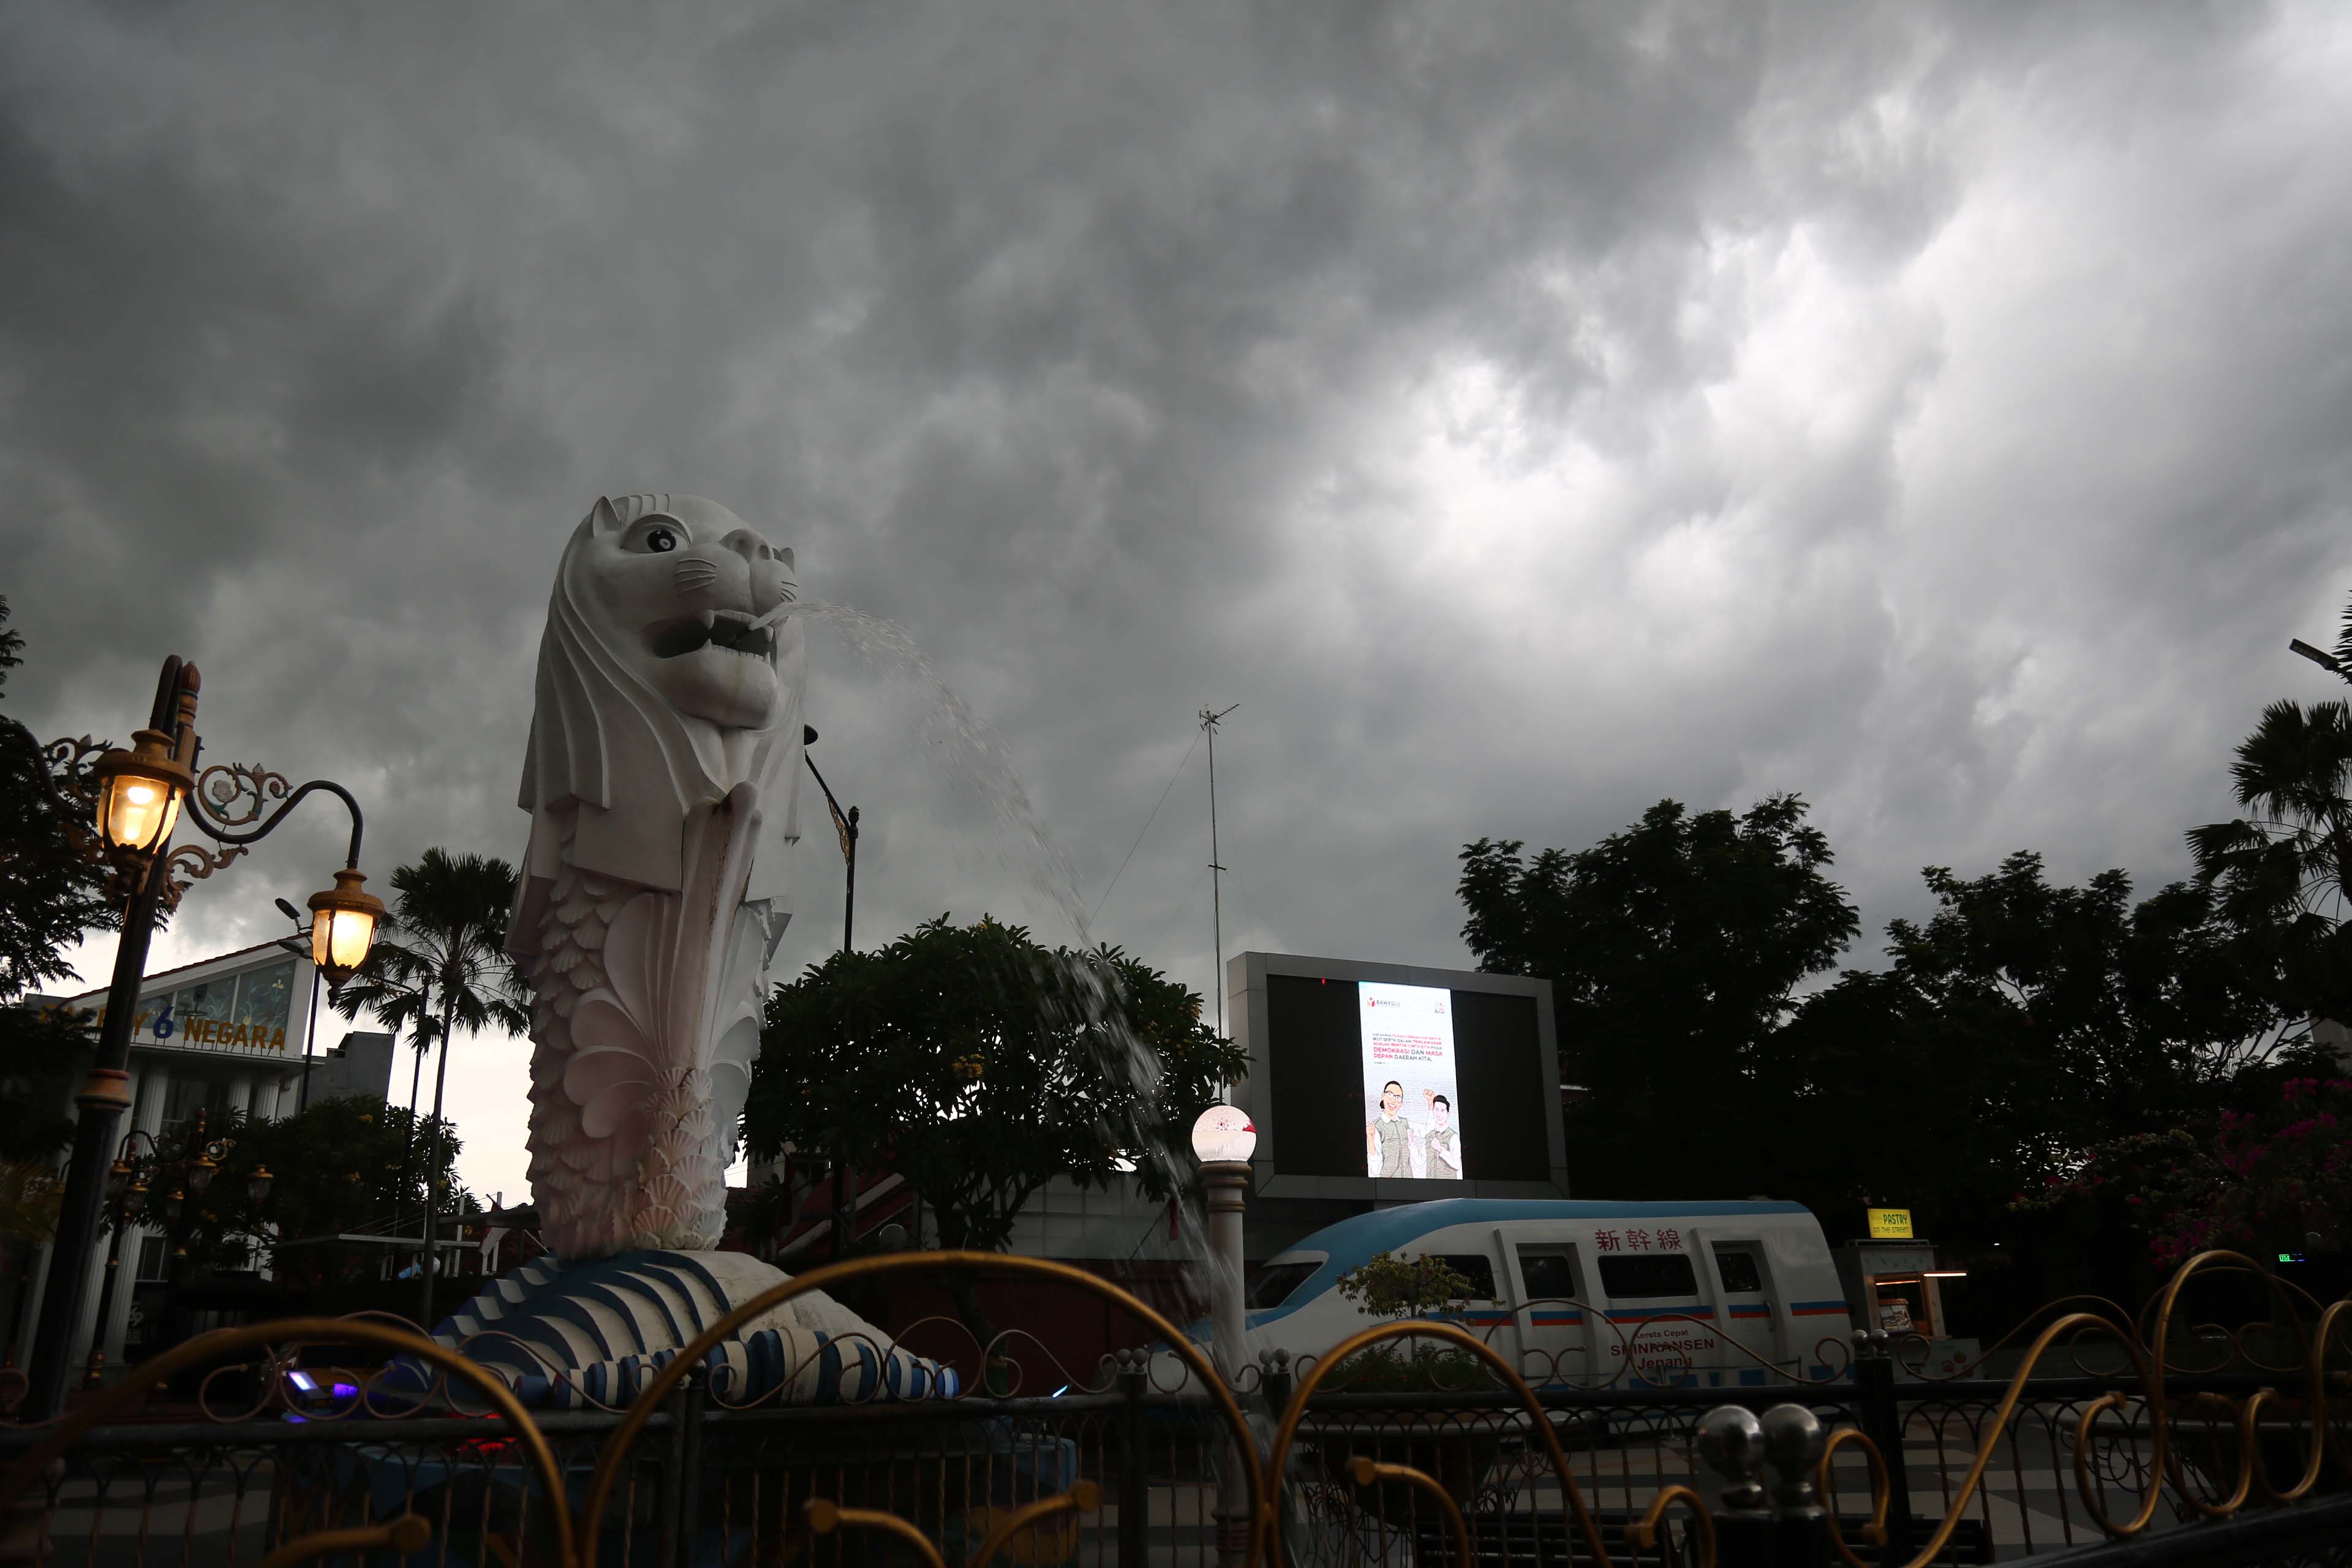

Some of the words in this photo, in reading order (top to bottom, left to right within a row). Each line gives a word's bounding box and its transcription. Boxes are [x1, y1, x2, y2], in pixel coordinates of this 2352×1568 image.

[153, 1005, 173, 1038] 6
[184, 1017, 285, 1051] NEGARA
[1883, 1214, 1907, 1224] PASTRY
[1595, 1229, 1683, 1251] 新幹線
[1664, 1329, 1689, 1338] Cepat
